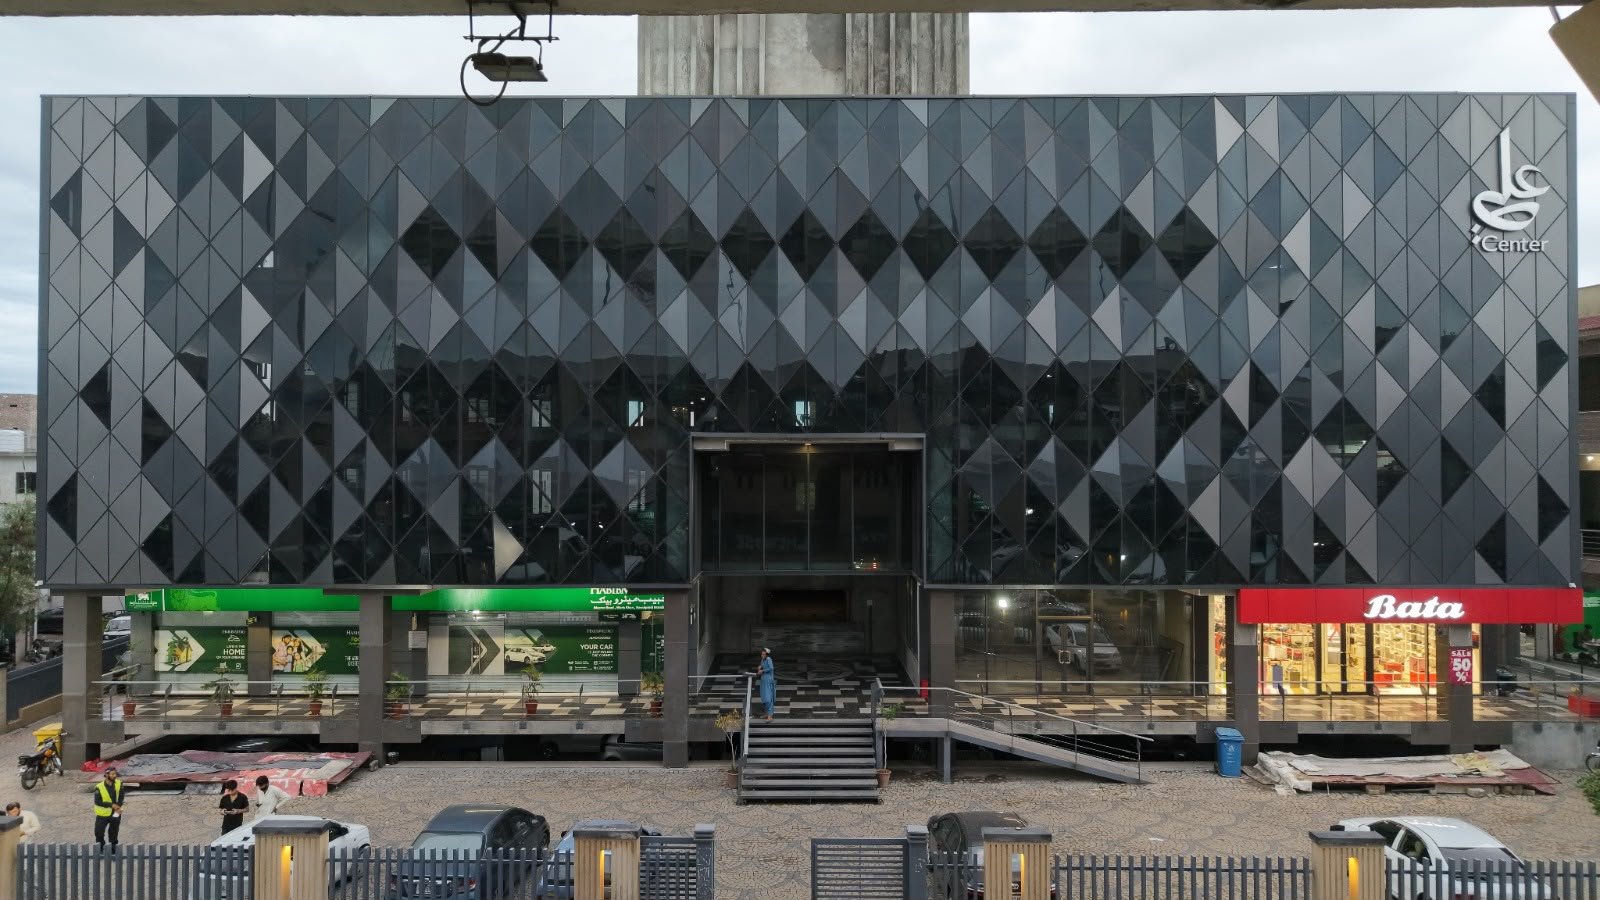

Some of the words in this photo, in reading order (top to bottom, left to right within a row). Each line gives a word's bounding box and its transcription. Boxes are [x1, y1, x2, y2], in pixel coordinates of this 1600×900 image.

[1481, 235, 1549, 252] Center
[1364, 594, 1465, 619] Bata
[223, 648, 246, 656] HOME
[1452, 658, 1471, 672] 50
